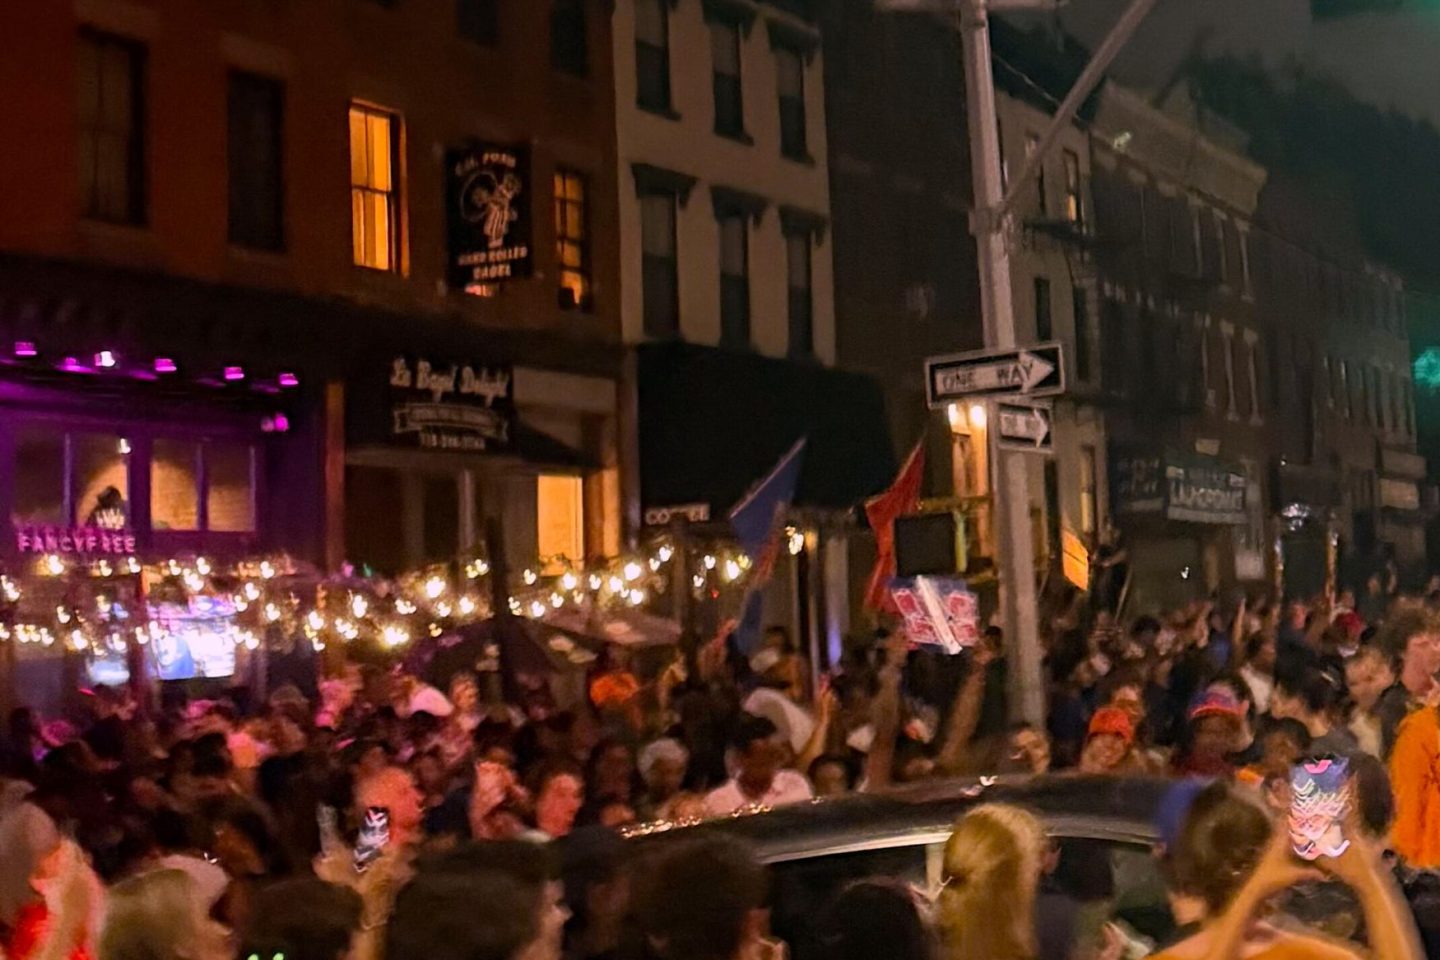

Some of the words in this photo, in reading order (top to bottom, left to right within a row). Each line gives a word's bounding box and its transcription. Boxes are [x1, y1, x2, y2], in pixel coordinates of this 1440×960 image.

[942, 368, 974, 391] ONE
[996, 359, 1034, 386] WAY
[17, 532, 135, 553] FANCYFREE
